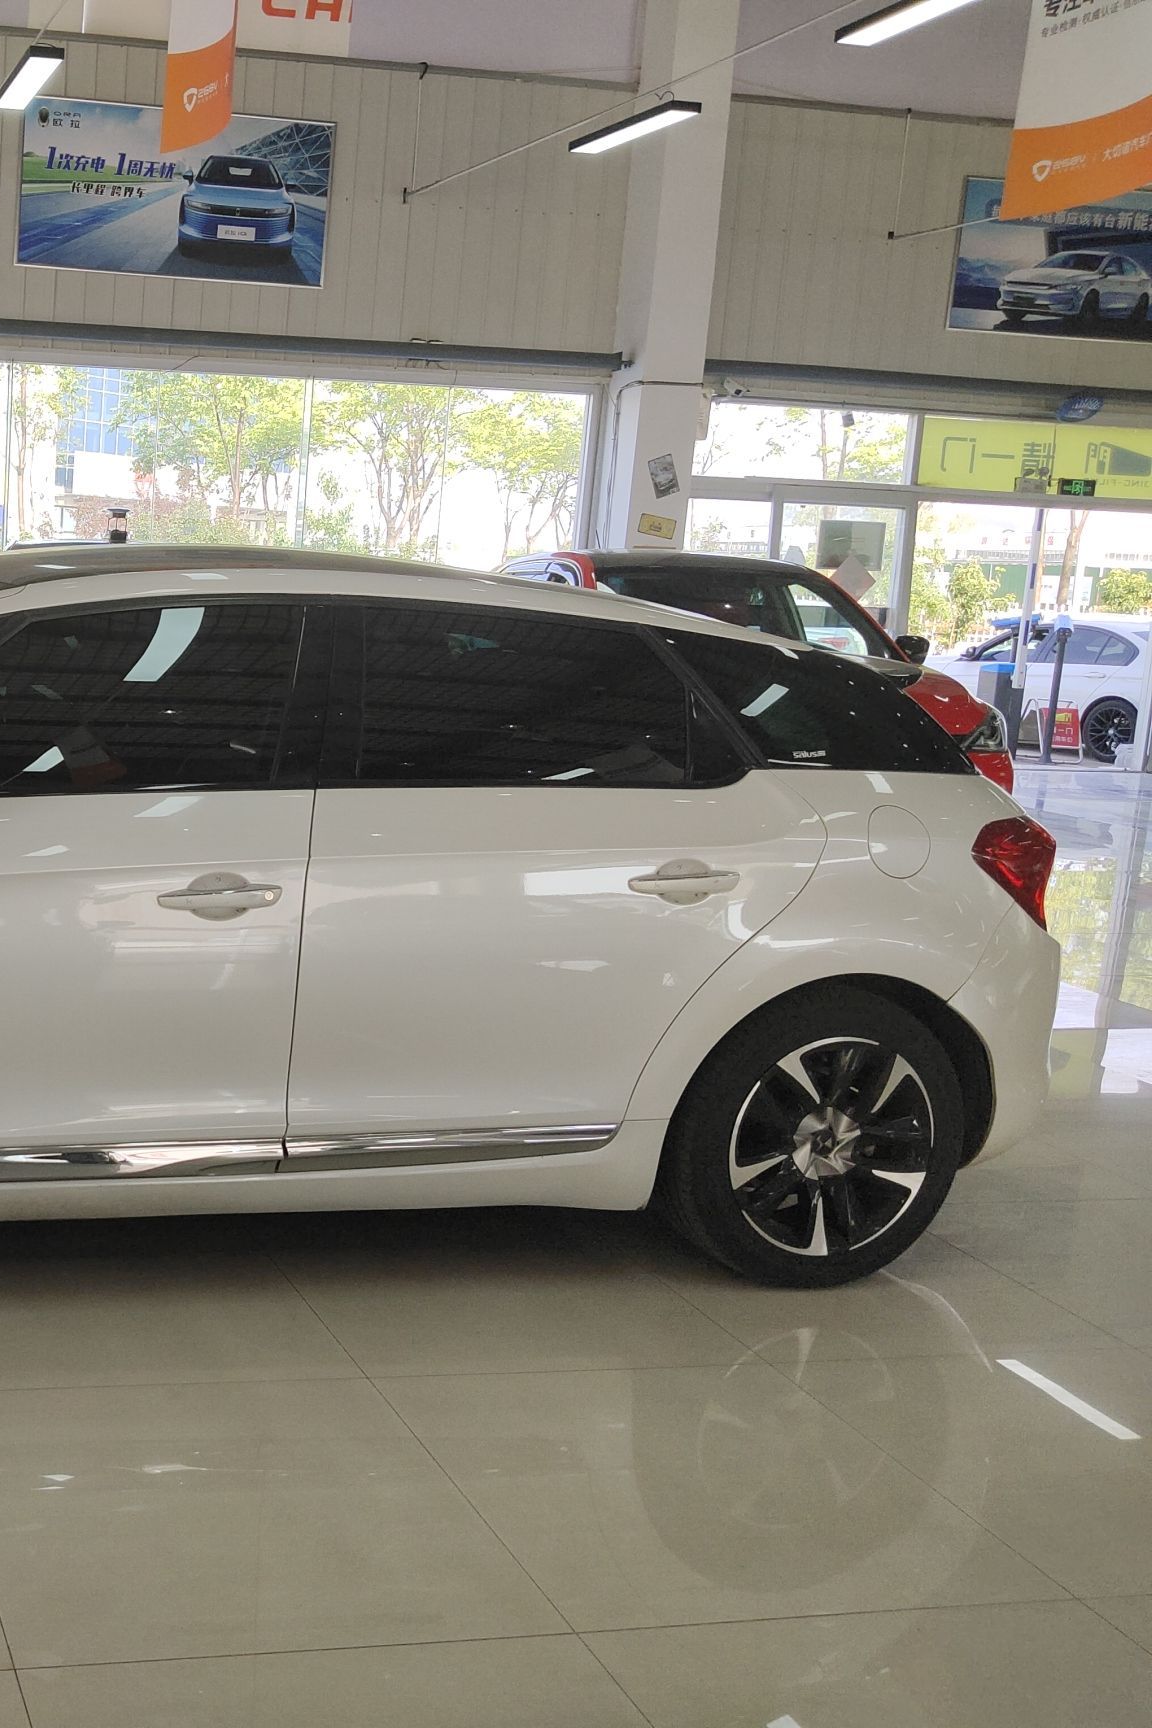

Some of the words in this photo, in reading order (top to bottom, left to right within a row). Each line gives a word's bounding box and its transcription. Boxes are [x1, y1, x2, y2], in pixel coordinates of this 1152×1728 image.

[52, 118, 81, 129] 欧拉
[44, 146, 106, 174] 1次充电
[114, 152, 177, 179] 1周无忧
[70, 181, 107, 196] 长里程
[110, 185, 147, 199] 跨界车
